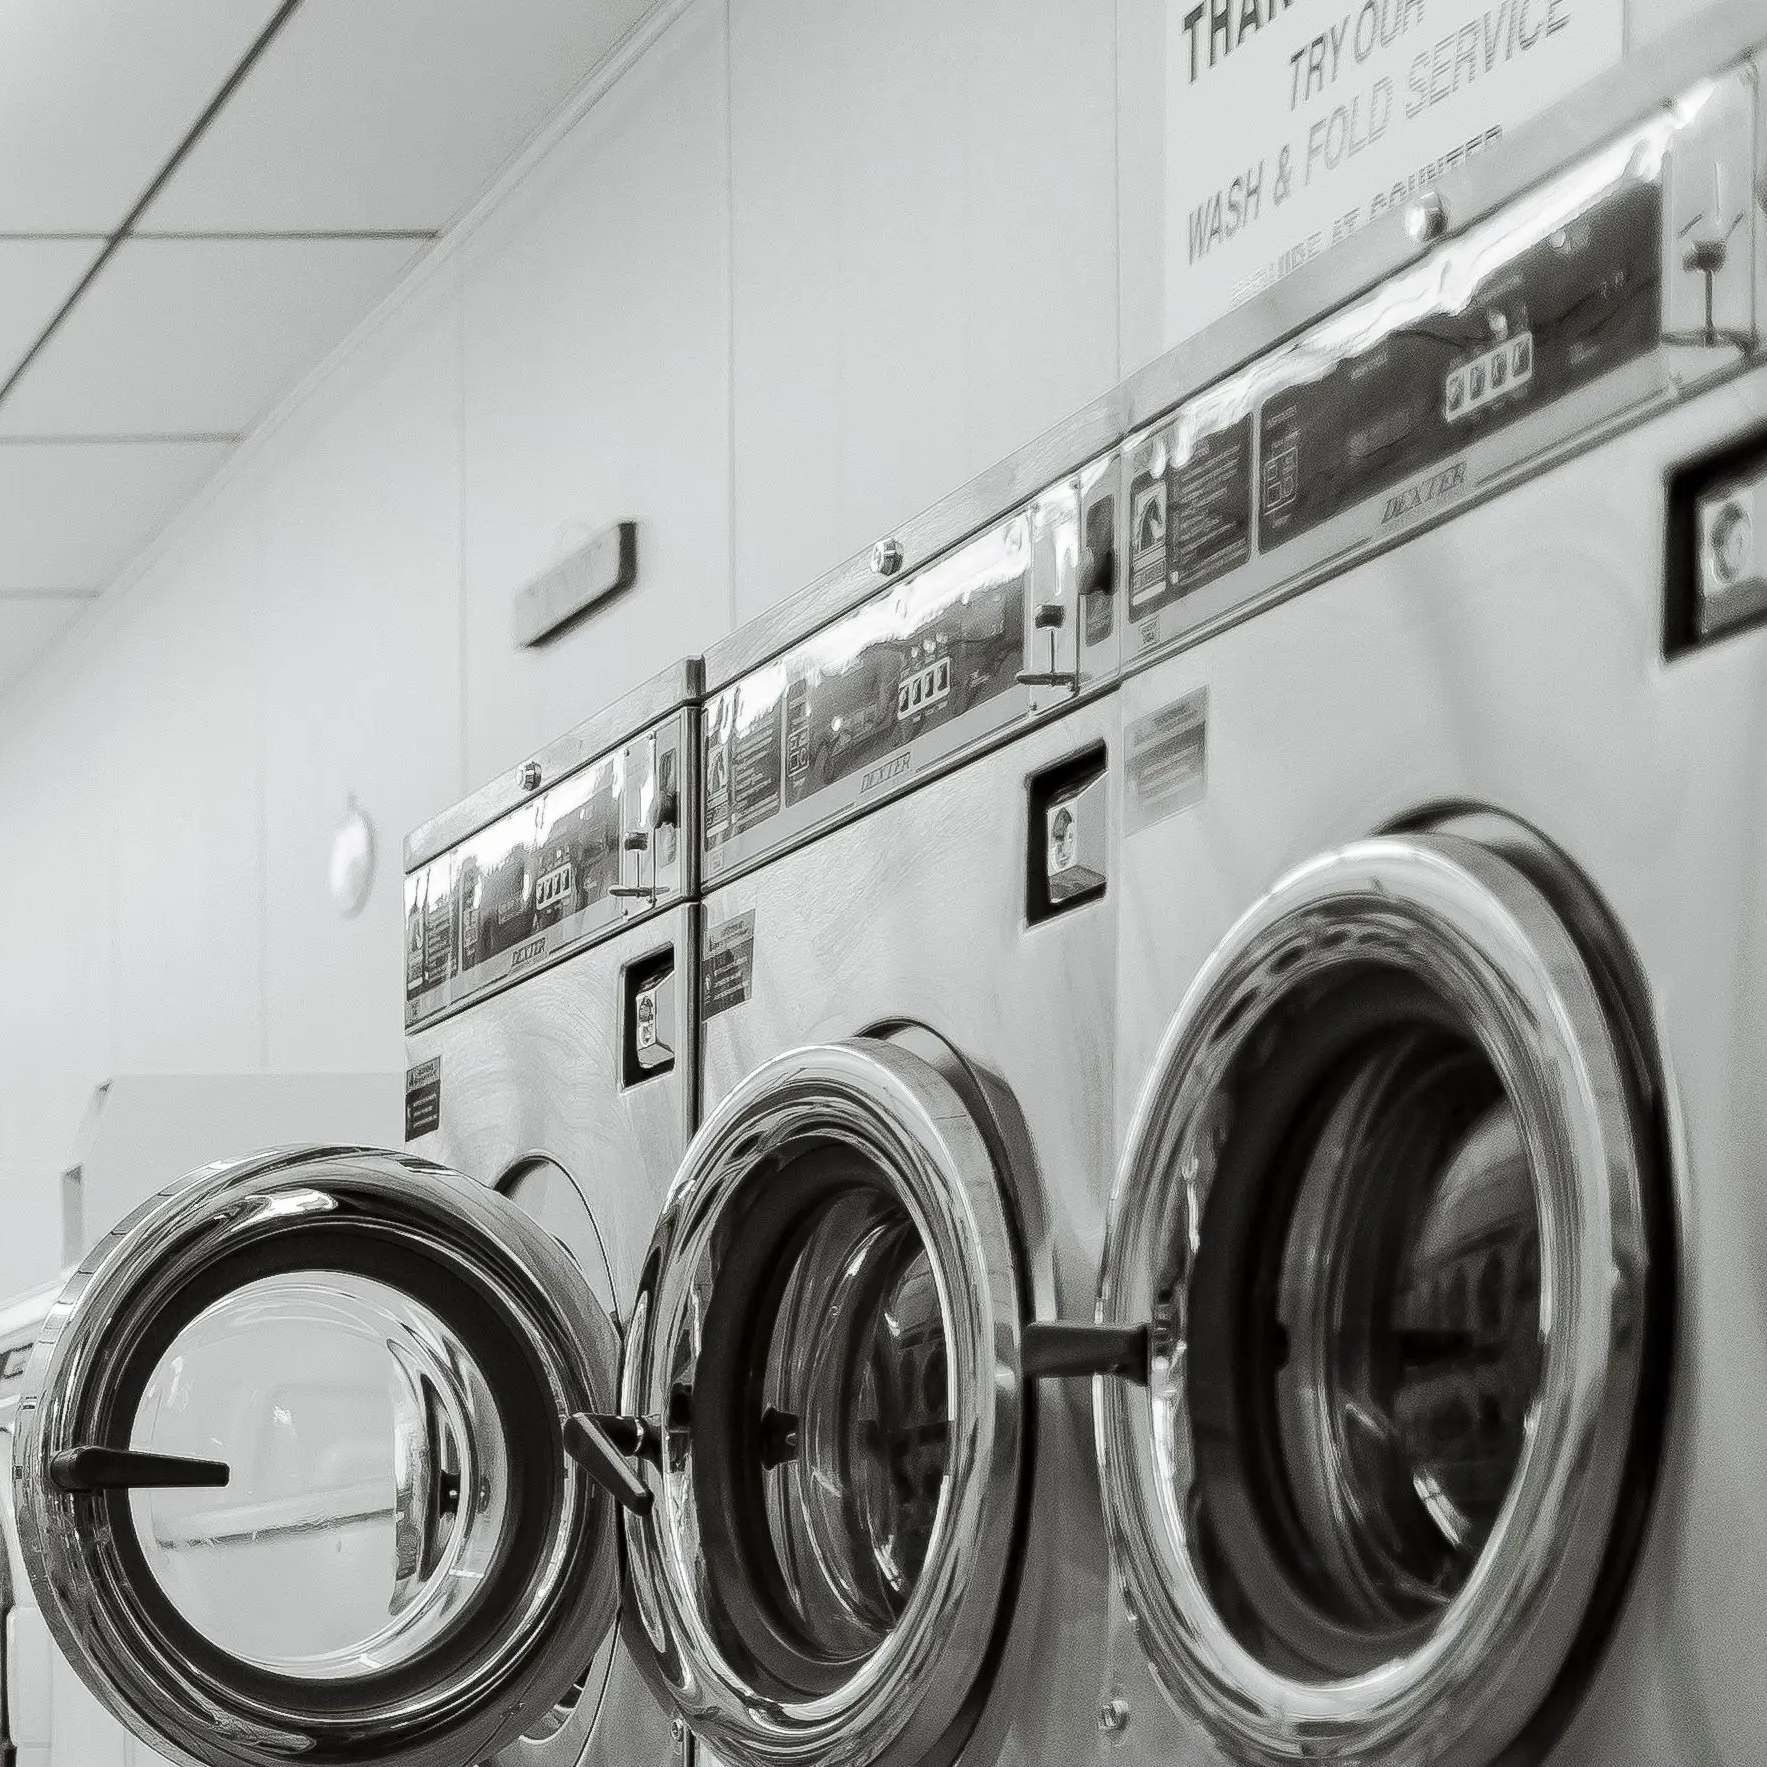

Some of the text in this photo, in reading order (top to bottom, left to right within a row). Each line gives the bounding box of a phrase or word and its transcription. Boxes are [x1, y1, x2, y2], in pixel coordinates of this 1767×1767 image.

[1183, 0, 1292, 84] THA
[1290, 14, 1351, 111] TRY
[1186, 158, 1265, 266] WASH
[1273, 143, 1291, 207] &
[1303, 76, 1393, 187] FOLD
[1404, 0, 1571, 119] SERVICE
[859, 751, 911, 795] DEXTER
